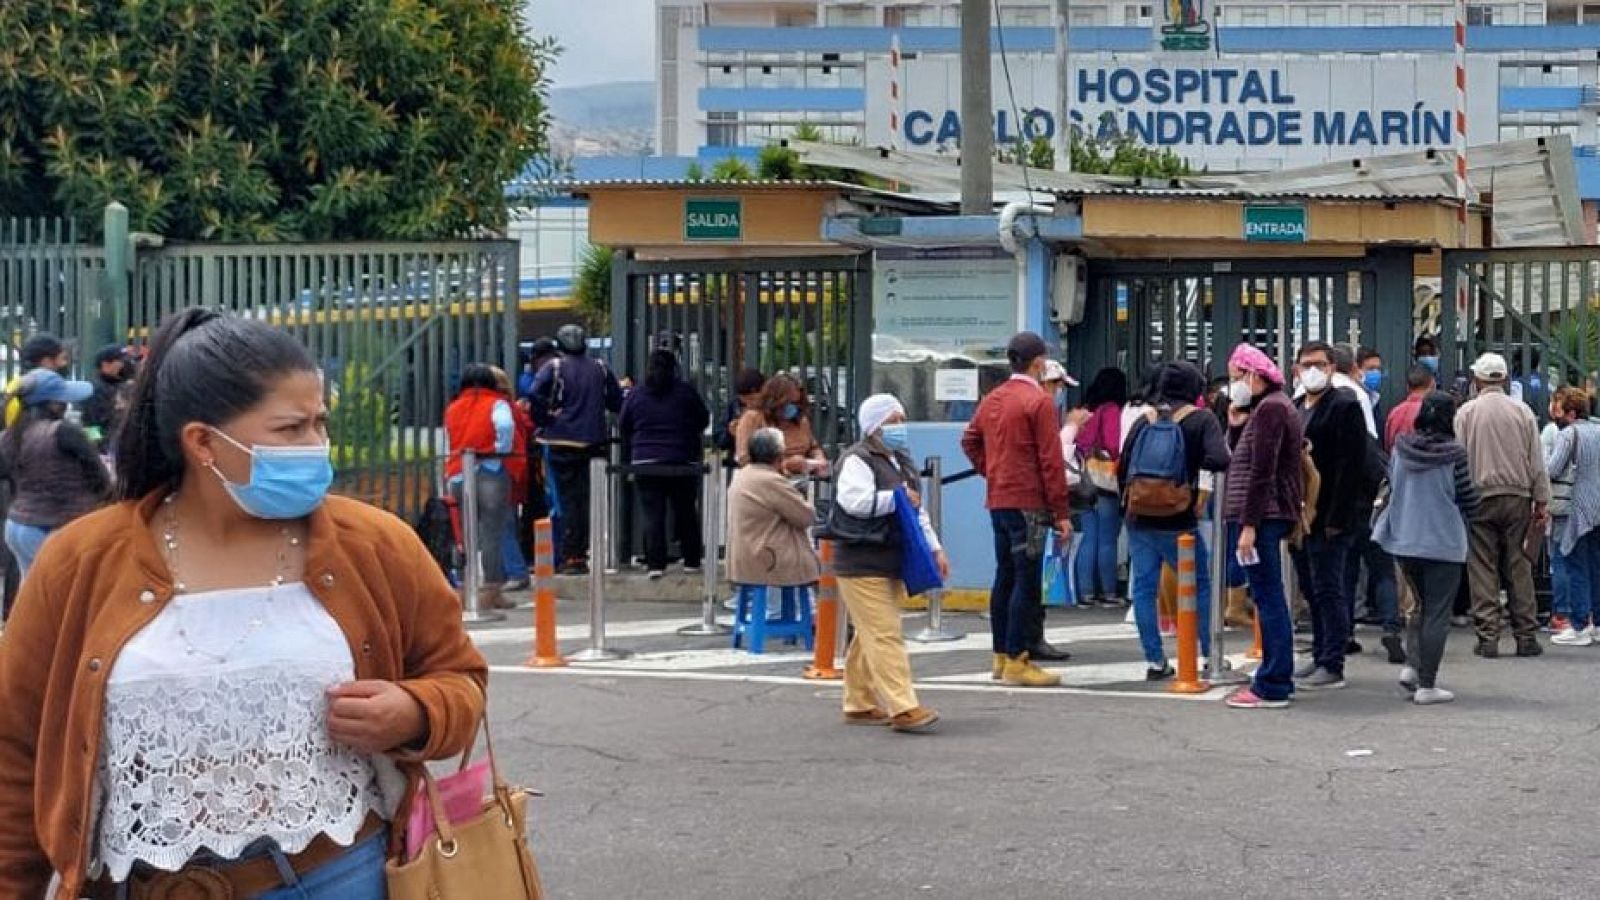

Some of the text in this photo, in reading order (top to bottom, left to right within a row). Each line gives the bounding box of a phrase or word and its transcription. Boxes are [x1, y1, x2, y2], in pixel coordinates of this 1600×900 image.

[1078, 69, 1294, 105] HOSPITAL
[1096, 110, 1302, 145] ANDRADE
[1313, 101, 1452, 145] MARÍN
[687, 213, 740, 227] SALIDA
[1246, 222, 1304, 236] ENTRADA
